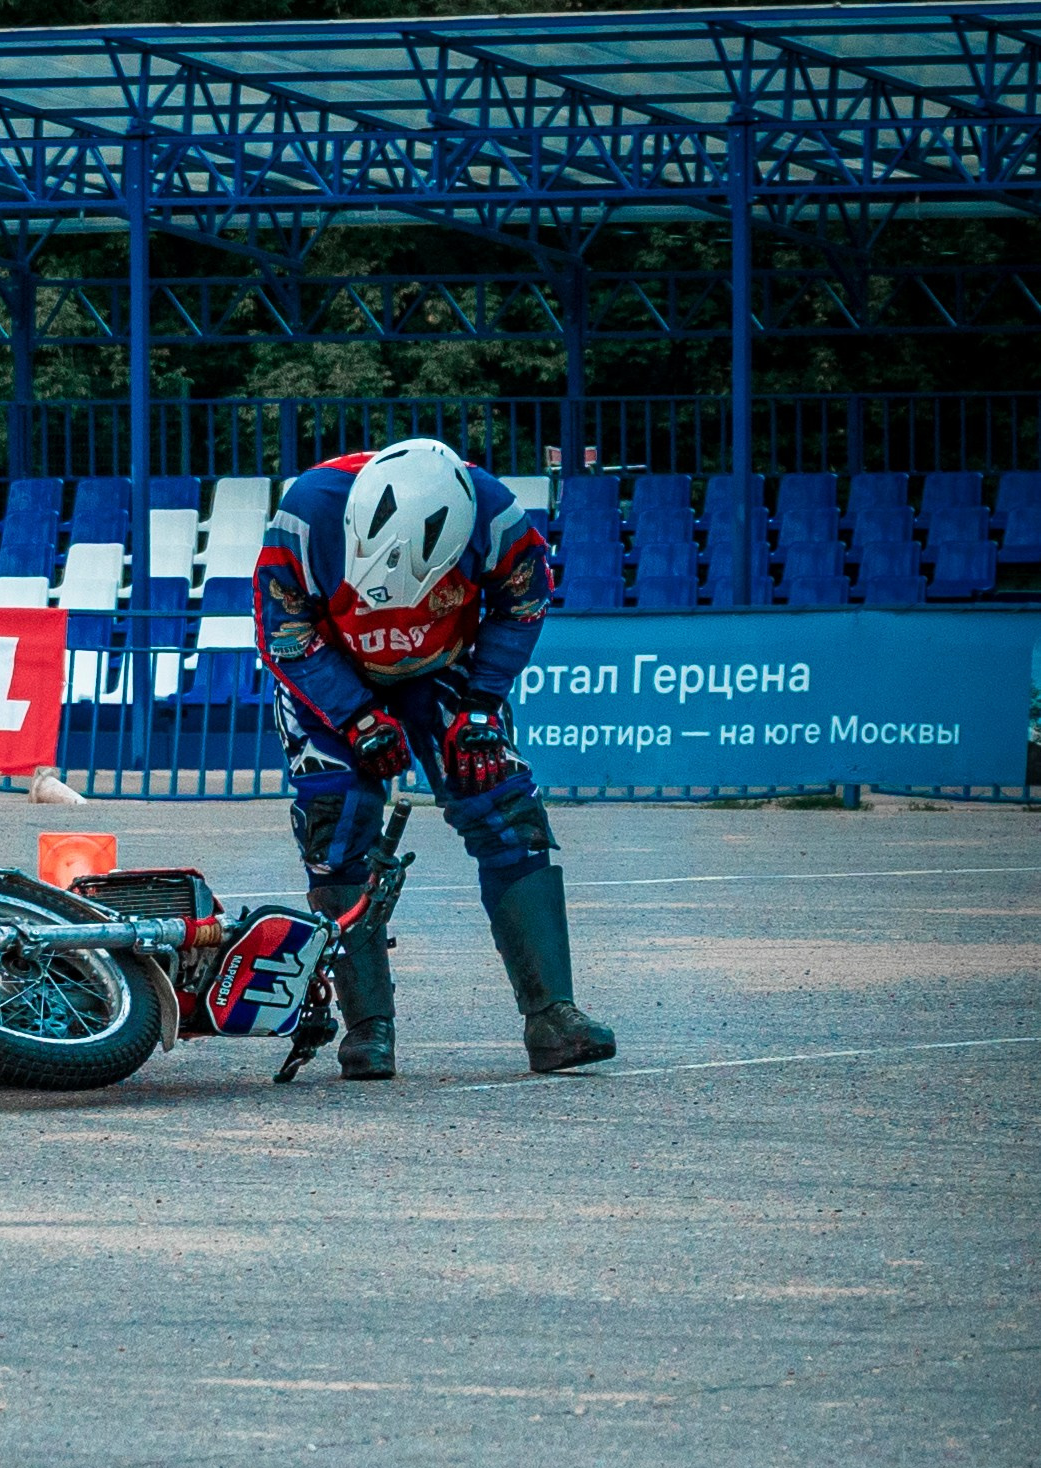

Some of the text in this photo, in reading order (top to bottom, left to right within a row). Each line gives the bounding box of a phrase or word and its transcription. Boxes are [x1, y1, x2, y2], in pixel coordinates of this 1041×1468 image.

[510, 654, 811, 705] ртал Герцена
[527, 724, 672, 753] квартира
[720, 723, 755, 745] на
[764, 723, 820, 745] юге
[830, 715, 960, 745] Москвы
